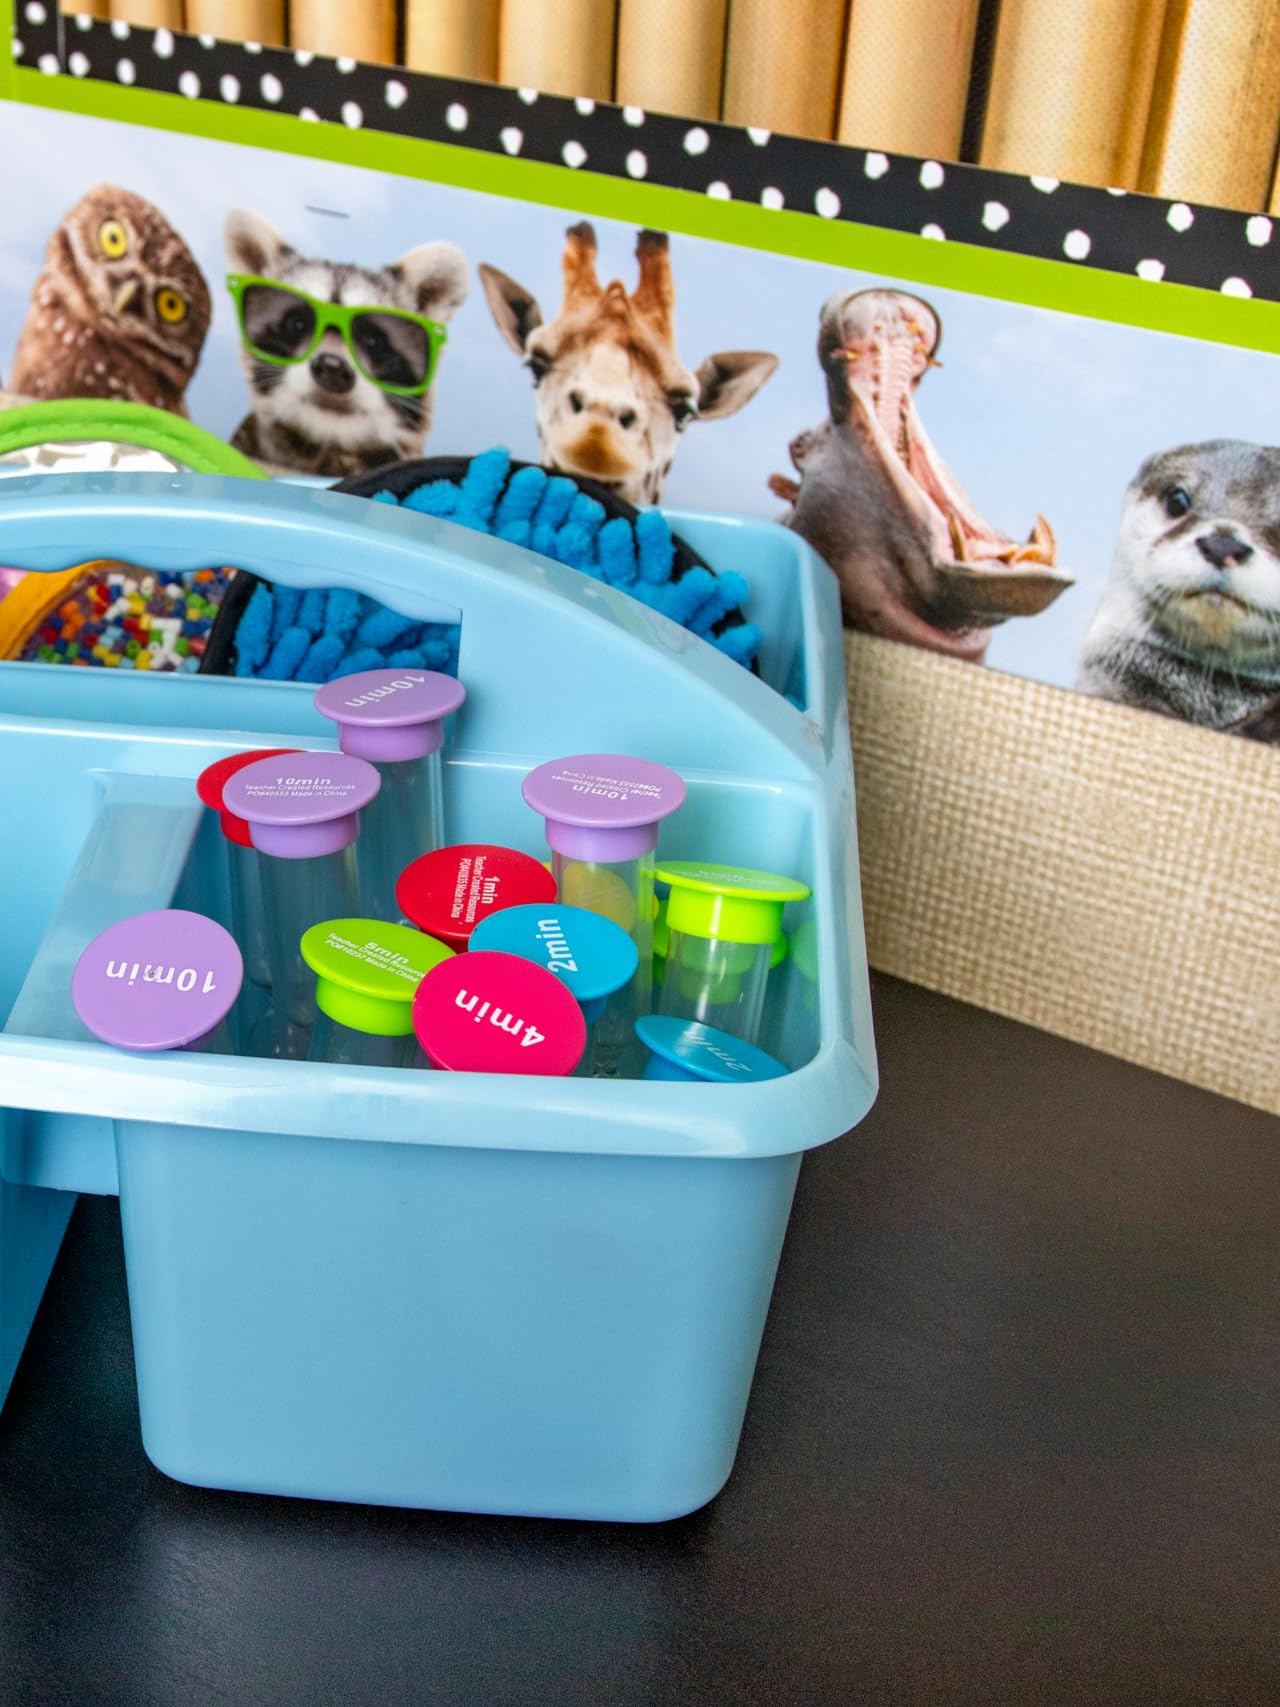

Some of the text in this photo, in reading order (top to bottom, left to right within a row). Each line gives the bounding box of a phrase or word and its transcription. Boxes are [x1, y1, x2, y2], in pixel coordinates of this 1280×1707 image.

[343, 675, 425, 707] 10min
[275, 777, 331, 785] 10min
[572, 784, 629, 801] 10min
[595, 776, 618, 785] Made
[470, 875, 484, 896] Created
[481, 875, 501, 904] 1min
[364, 941, 410, 965] 5min
[535, 918, 579, 973] 2min
[365, 957, 388, 970] Made
[105, 960, 217, 994] 10min
[454, 988, 546, 1048] 4min
[681, 1029, 753, 1072] 2min
